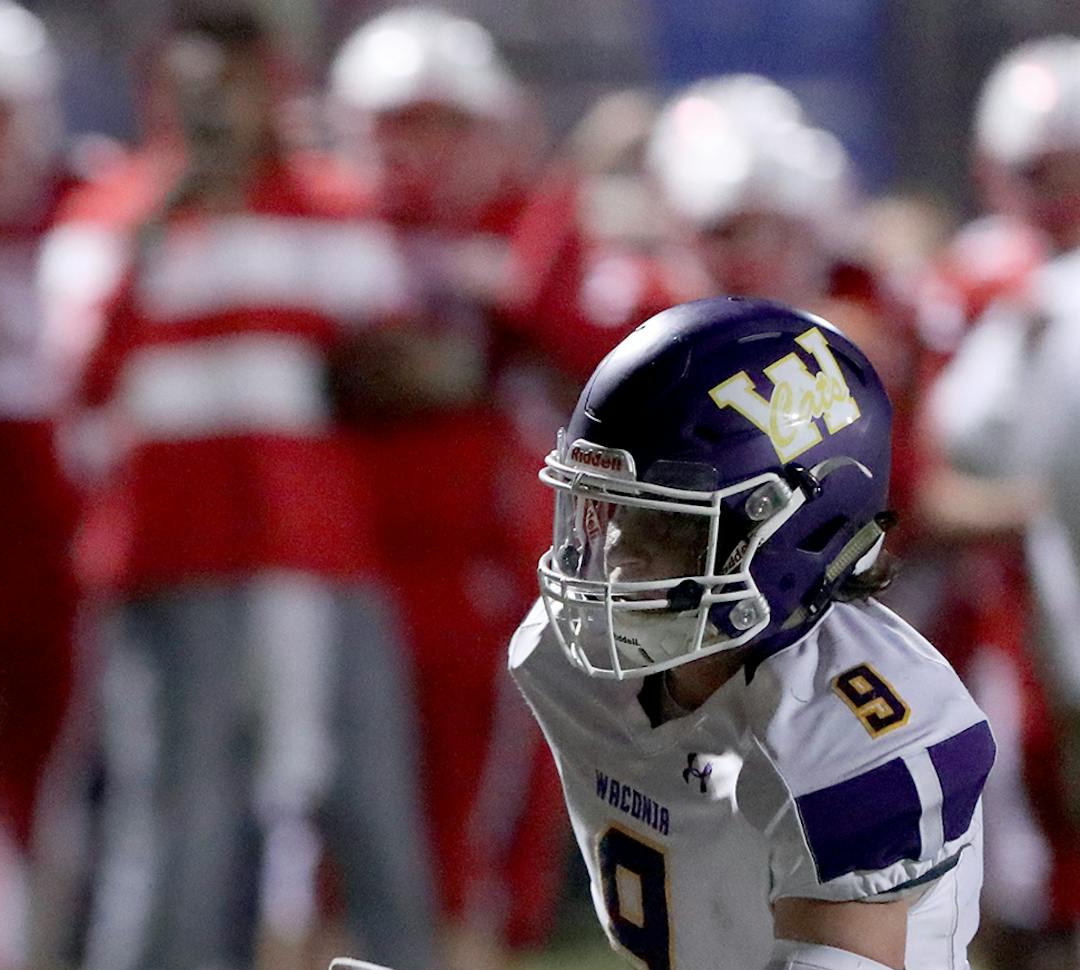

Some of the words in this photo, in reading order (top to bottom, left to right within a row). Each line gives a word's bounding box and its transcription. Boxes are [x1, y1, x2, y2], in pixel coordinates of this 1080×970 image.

[708, 326, 861, 465] W
[571, 446, 623, 472] Riddell
[831, 662, 911, 740] 9
[595, 768, 670, 836] WACONIA
